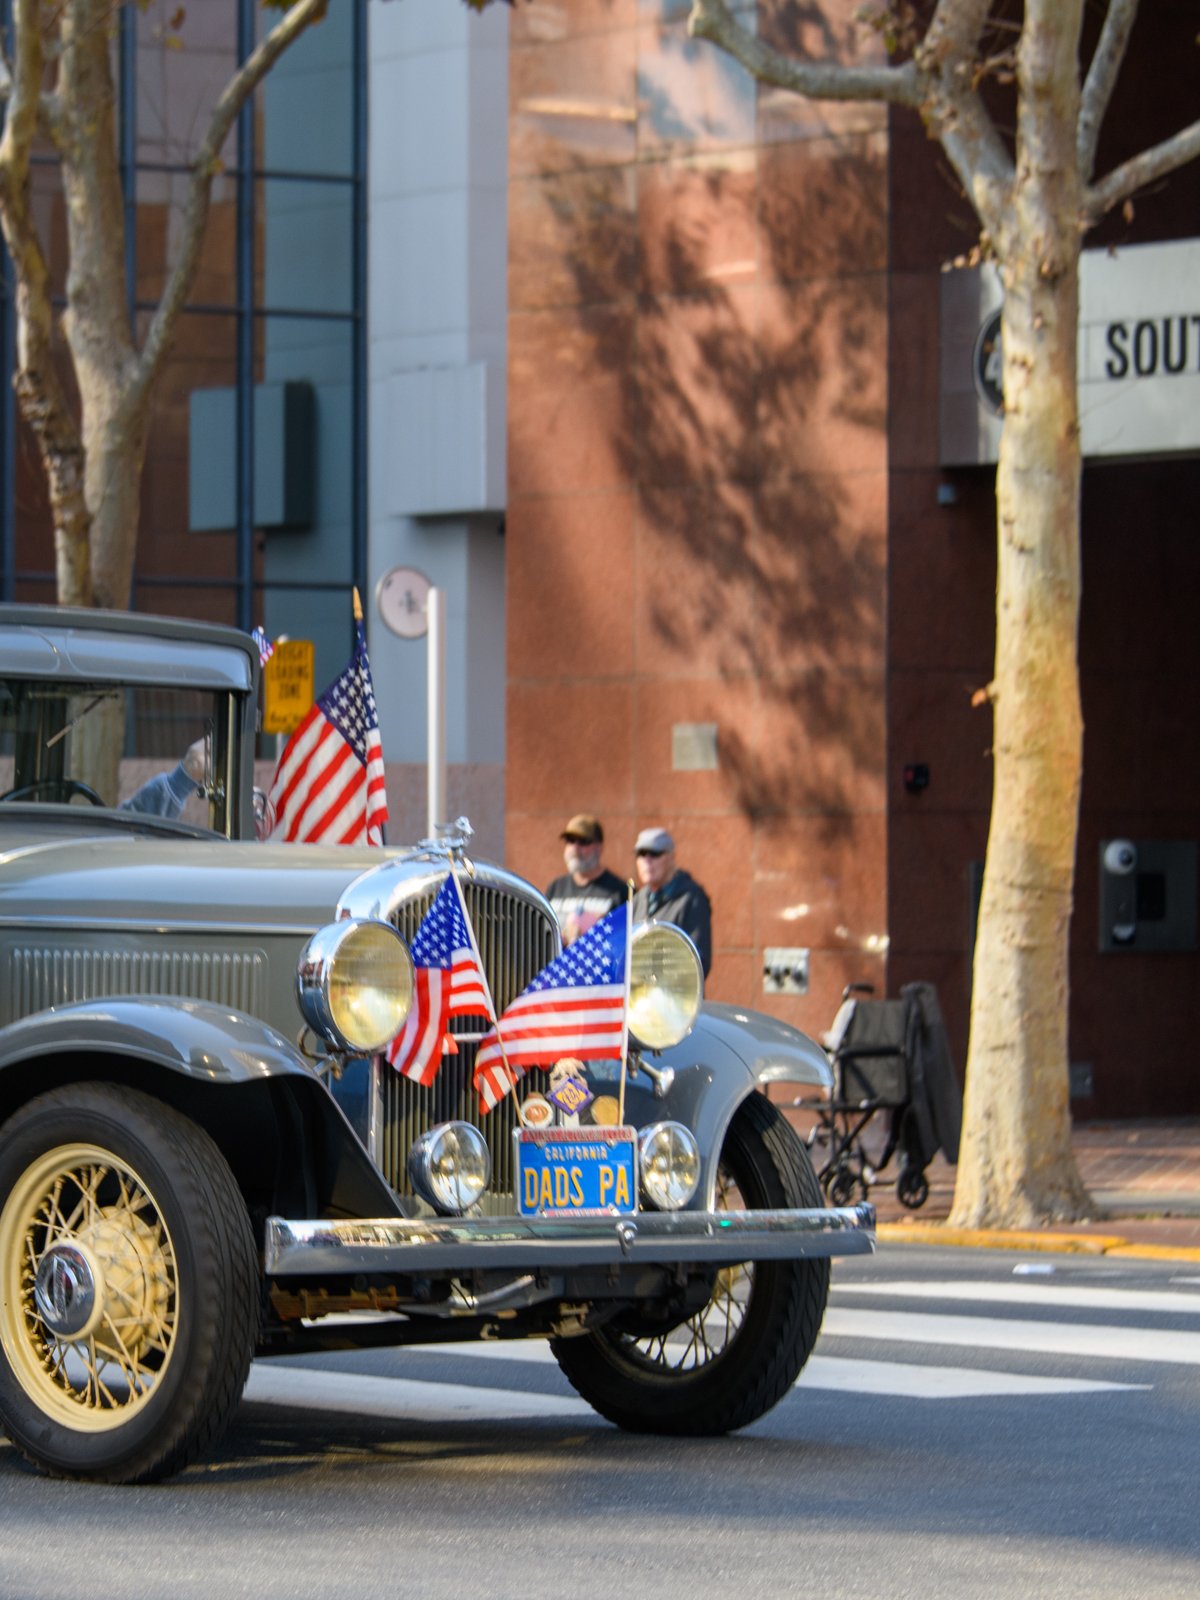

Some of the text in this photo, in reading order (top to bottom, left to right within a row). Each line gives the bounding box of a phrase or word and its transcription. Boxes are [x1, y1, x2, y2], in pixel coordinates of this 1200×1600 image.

[544, 1145, 608, 1162] CALIFORNIA
[523, 1163, 630, 1208] DADS PA
